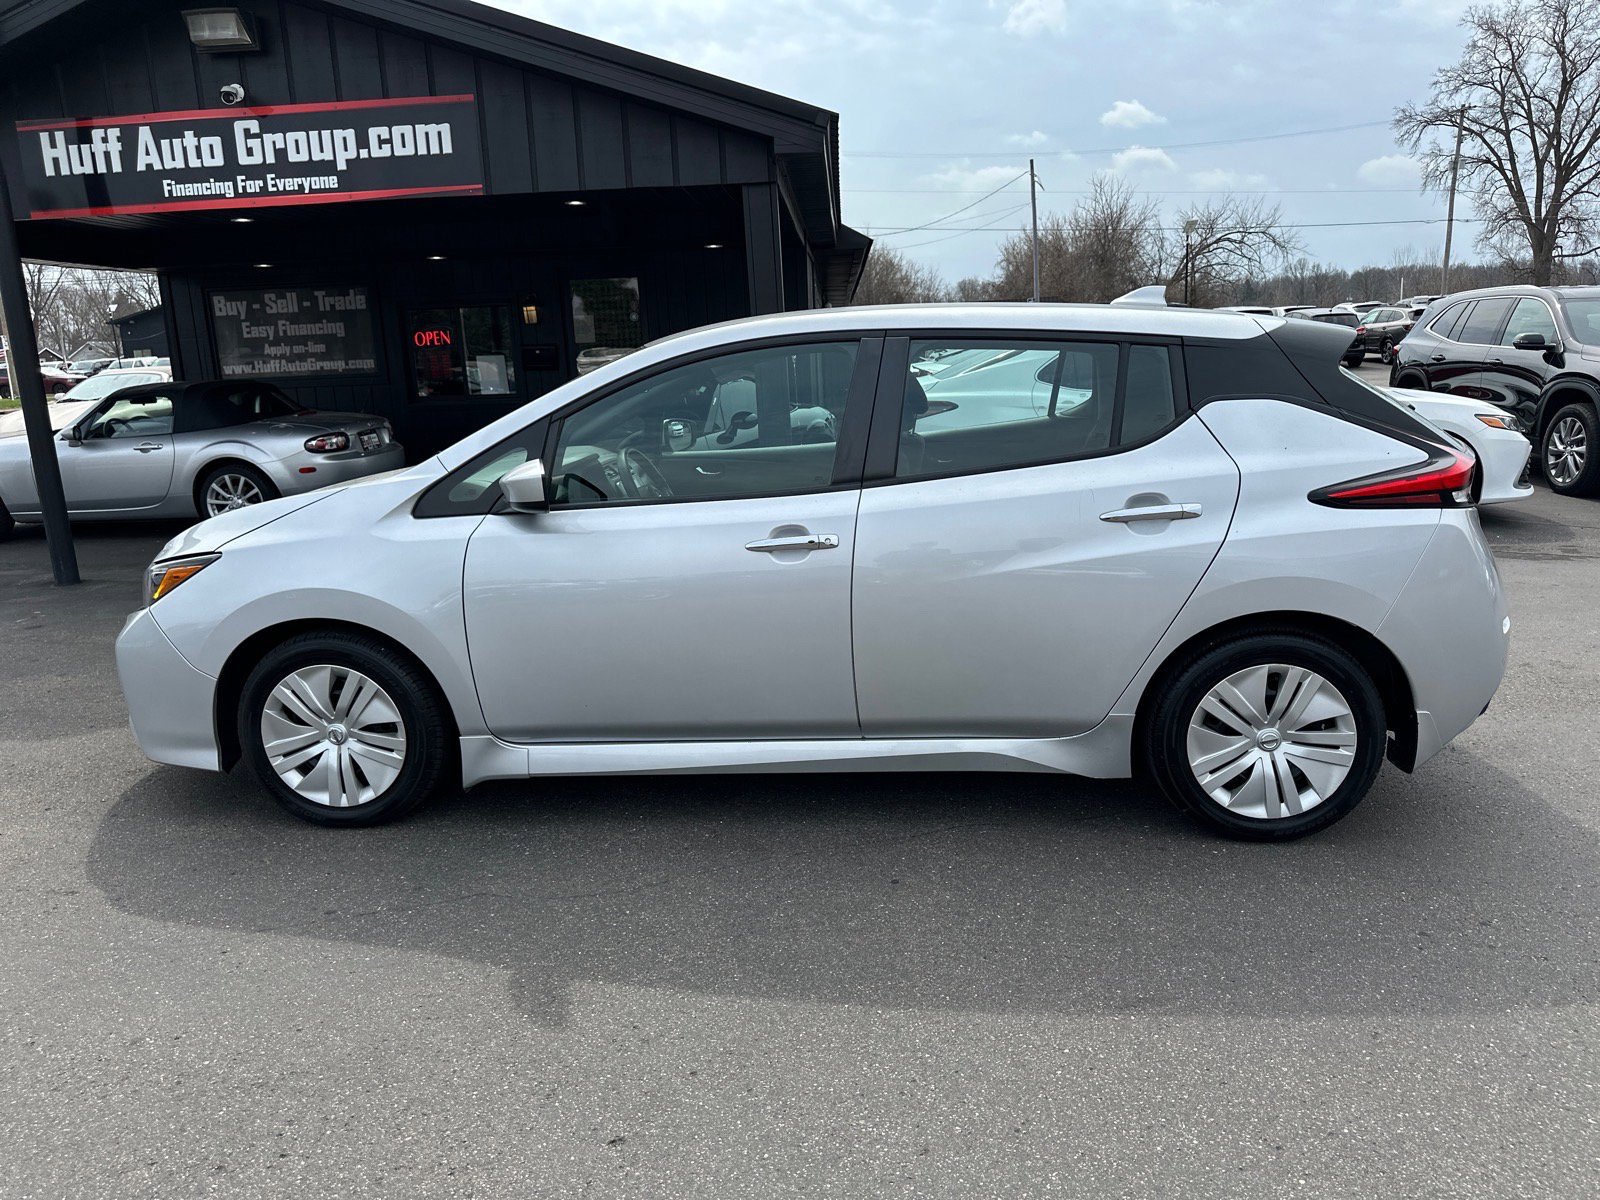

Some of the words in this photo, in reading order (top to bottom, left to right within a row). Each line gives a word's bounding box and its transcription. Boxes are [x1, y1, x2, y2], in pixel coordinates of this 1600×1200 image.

[39, 128, 123, 177] Huff
[136, 126, 225, 172] Auto
[233, 119, 453, 171] Group.com
[163, 178, 235, 198] Financing
[237, 176, 264, 194] For
[267, 174, 339, 193] Everyone
[213, 296, 247, 319] Buy
[264, 292, 299, 314] Sell
[314, 289, 366, 312] Trade
[241, 321, 275, 340] Easy
[277, 319, 345, 337] Financing
[414, 330, 451, 347] OPEN
[264, 342, 290, 357] Apply
[222, 358, 375, 375] www.HuffAutoGroup.com
